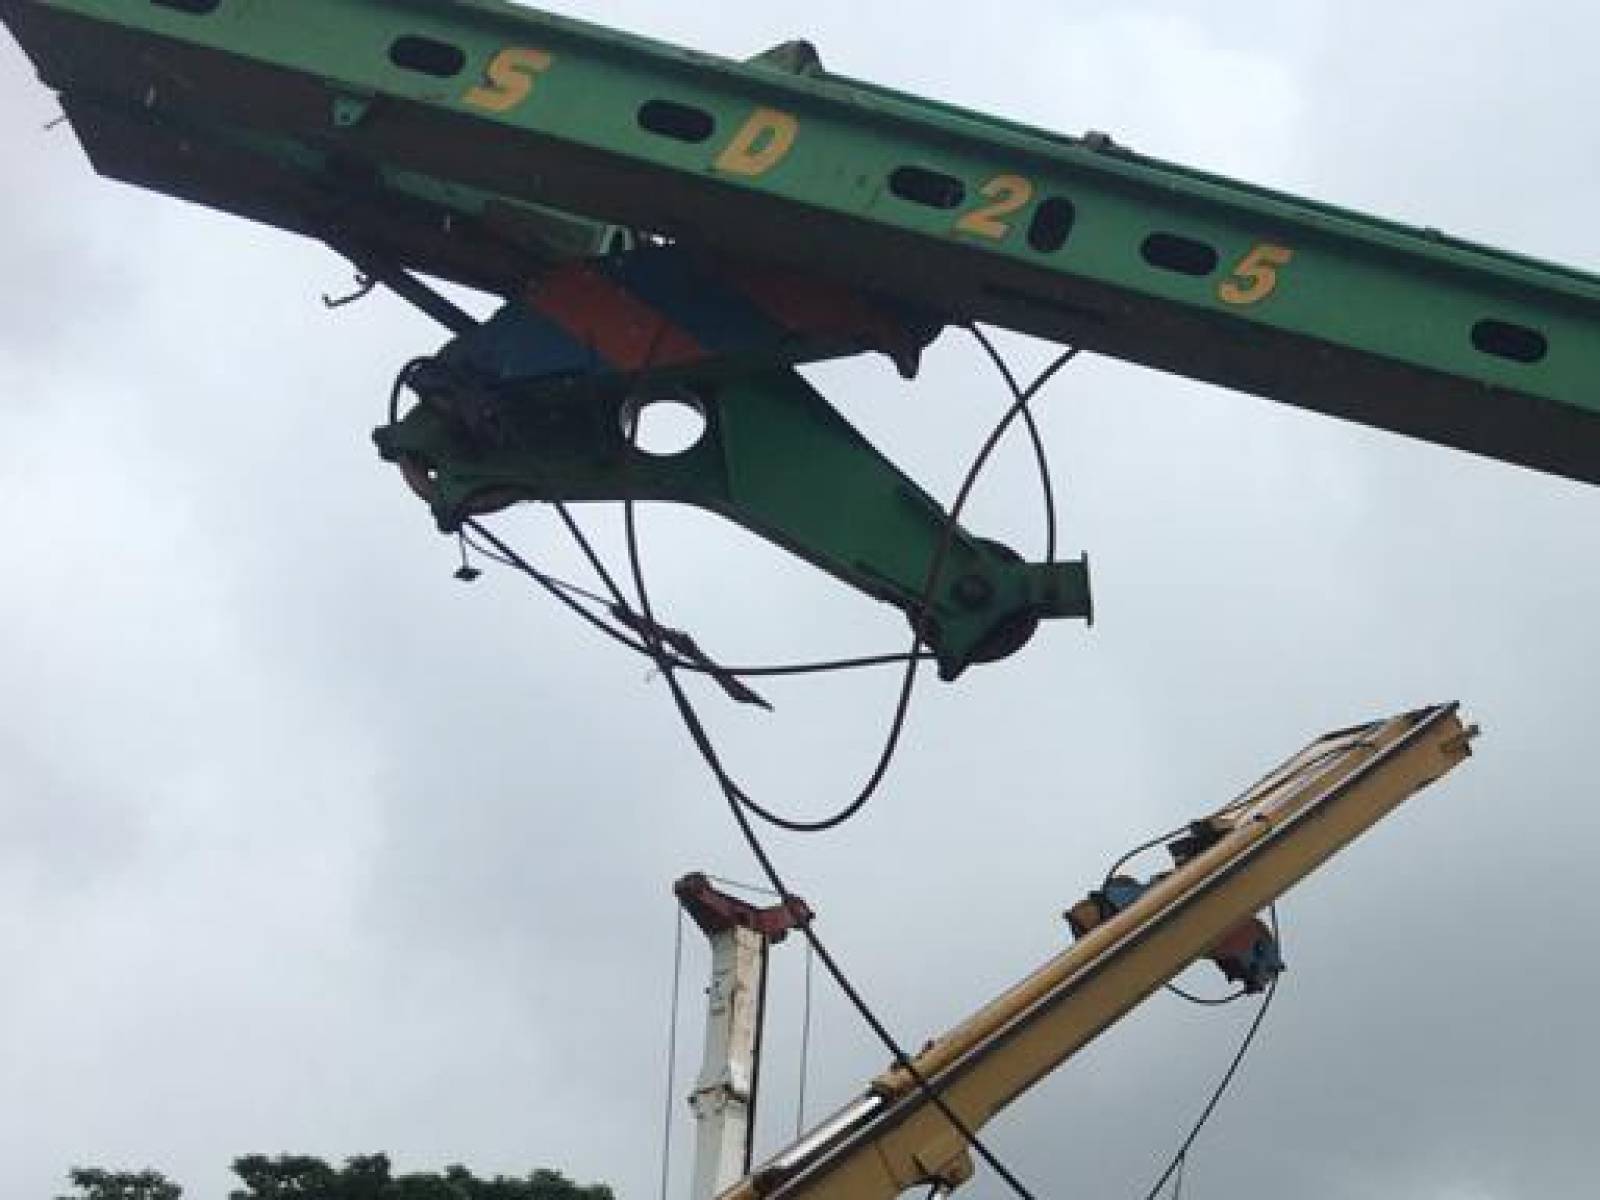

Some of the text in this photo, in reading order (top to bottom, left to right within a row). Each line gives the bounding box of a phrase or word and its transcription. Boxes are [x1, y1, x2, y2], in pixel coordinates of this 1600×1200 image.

[460, 46, 1291, 305] S D 2 5
